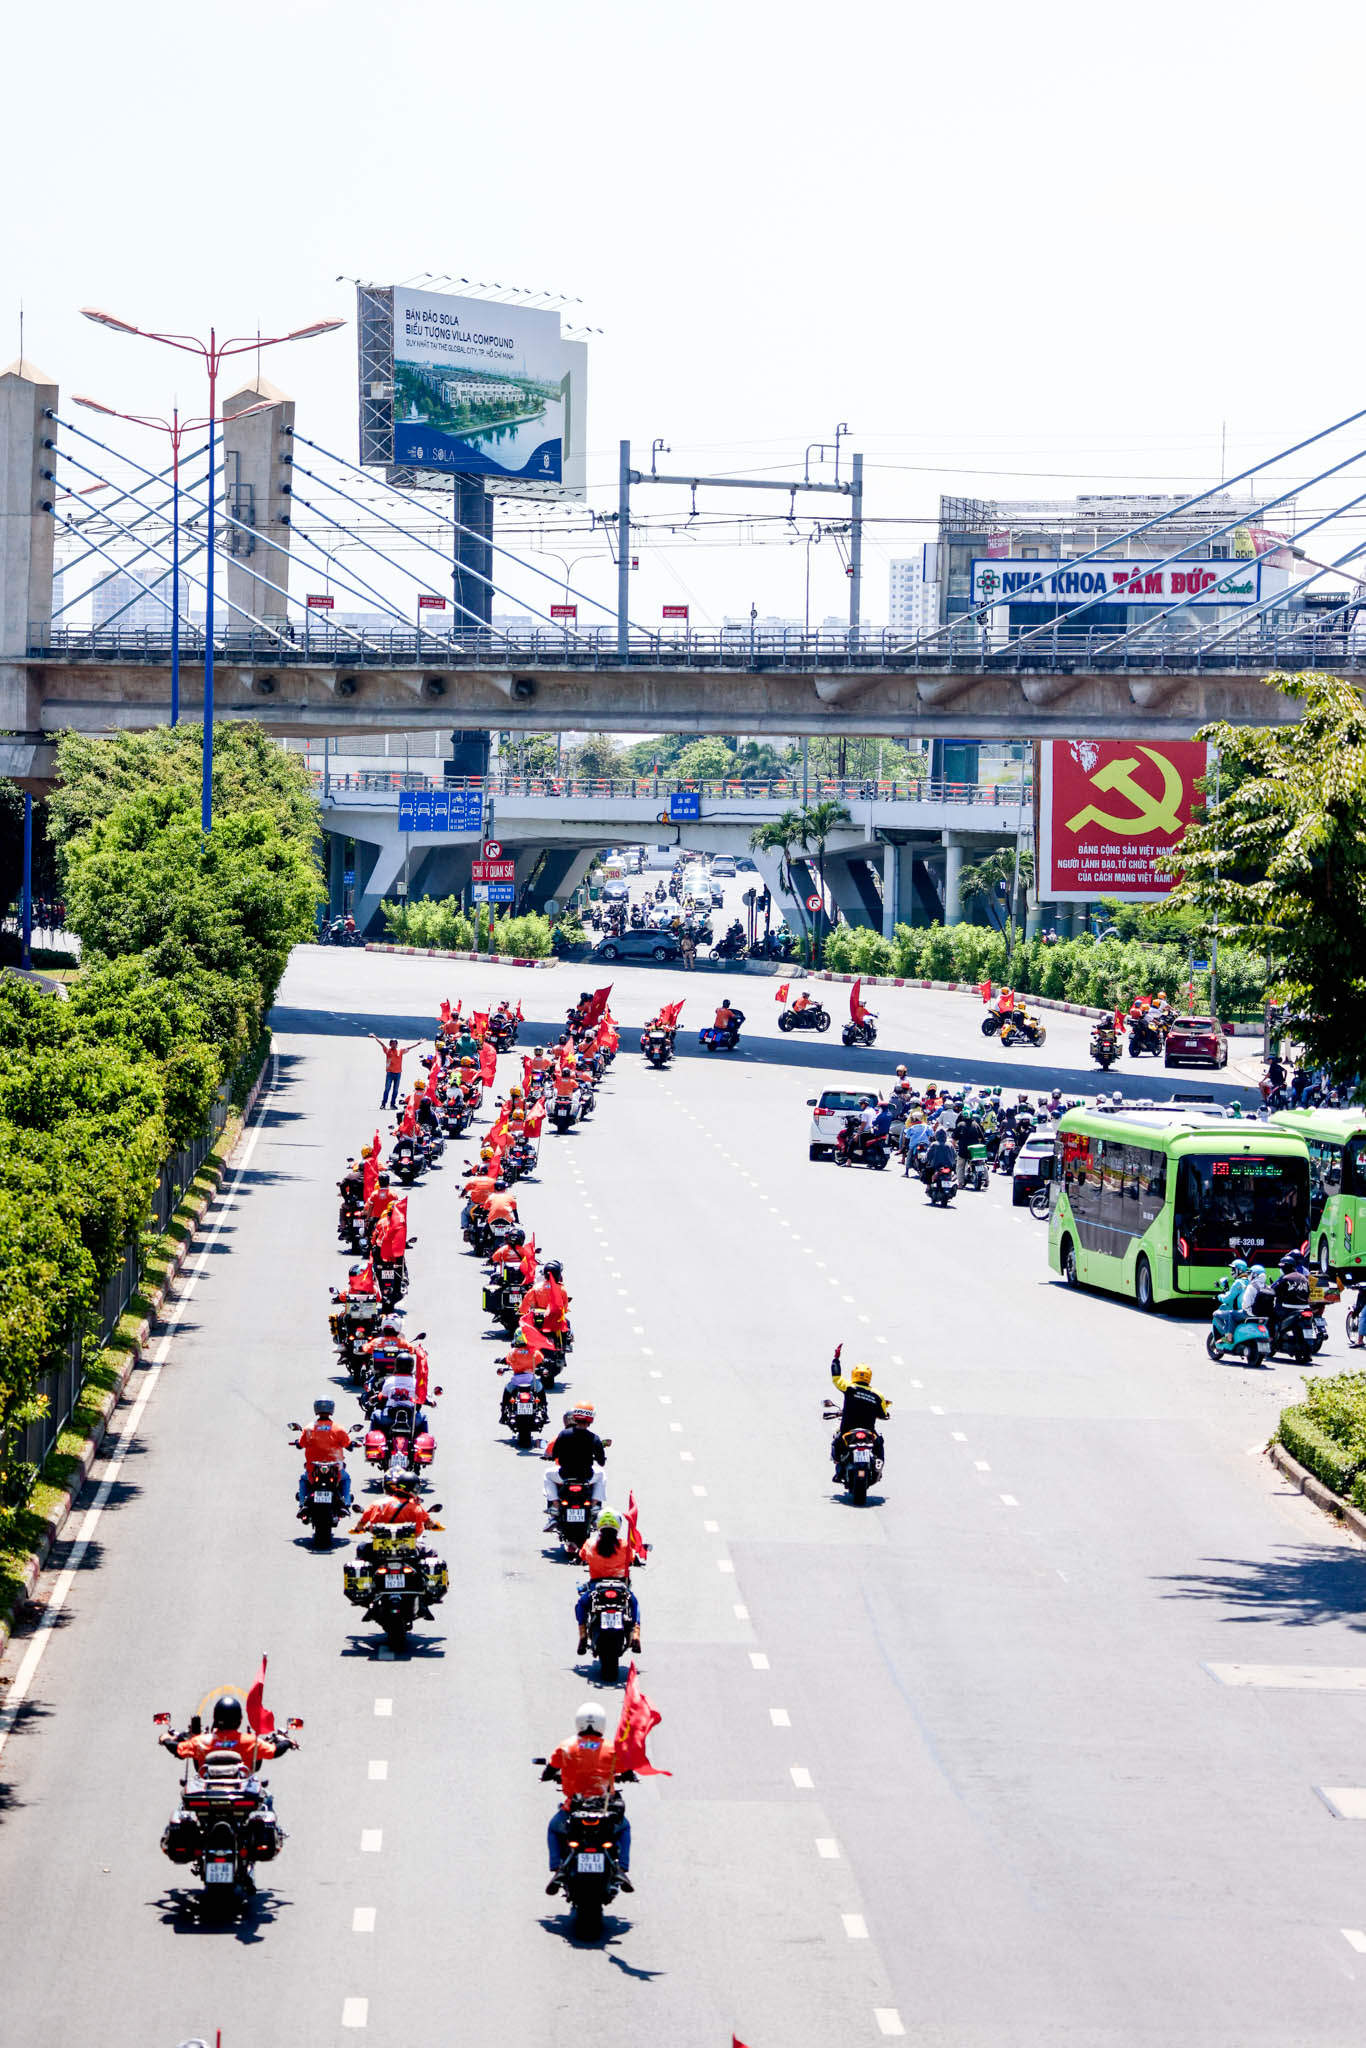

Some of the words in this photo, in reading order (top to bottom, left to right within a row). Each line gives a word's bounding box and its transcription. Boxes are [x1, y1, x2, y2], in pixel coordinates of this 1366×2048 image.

[440, 314, 459, 326] SOLA
[452, 330, 471, 342] VILLA
[473, 334, 514, 349] COMPOUND
[438, 343, 447, 351] THE
[448, 345, 466, 353] GLOBAL
[432, 447, 455, 463] SOLA
[1002, 572, 1043, 594] NHA
[1051, 572, 1107, 595] KHOA
[1113, 567, 1163, 594] TÂM
[1171, 567, 1217, 594] ĐỨC
[1218, 576, 1254, 595] Smile
[1078, 842, 1098, 854] ĐẢNG
[1100, 843, 1120, 856] CỘNG
[1122, 842, 1137, 855] SẢN
[1139, 844, 1154, 857] VIỆT
[485, 863, 489, 877] Ý
[489, 865, 504, 878] QUAN
[505, 863, 514, 877] SÁT
[1057, 857, 1079, 868] NGƯỜI
[1128, 858, 1147, 869] CHỨC
[1078, 869, 1092, 882] CỦA
[1094, 871, 1113, 882] CÁCH
[1114, 872, 1136, 884] MẠNG
[1137, 872, 1152, 884] VIỆT
